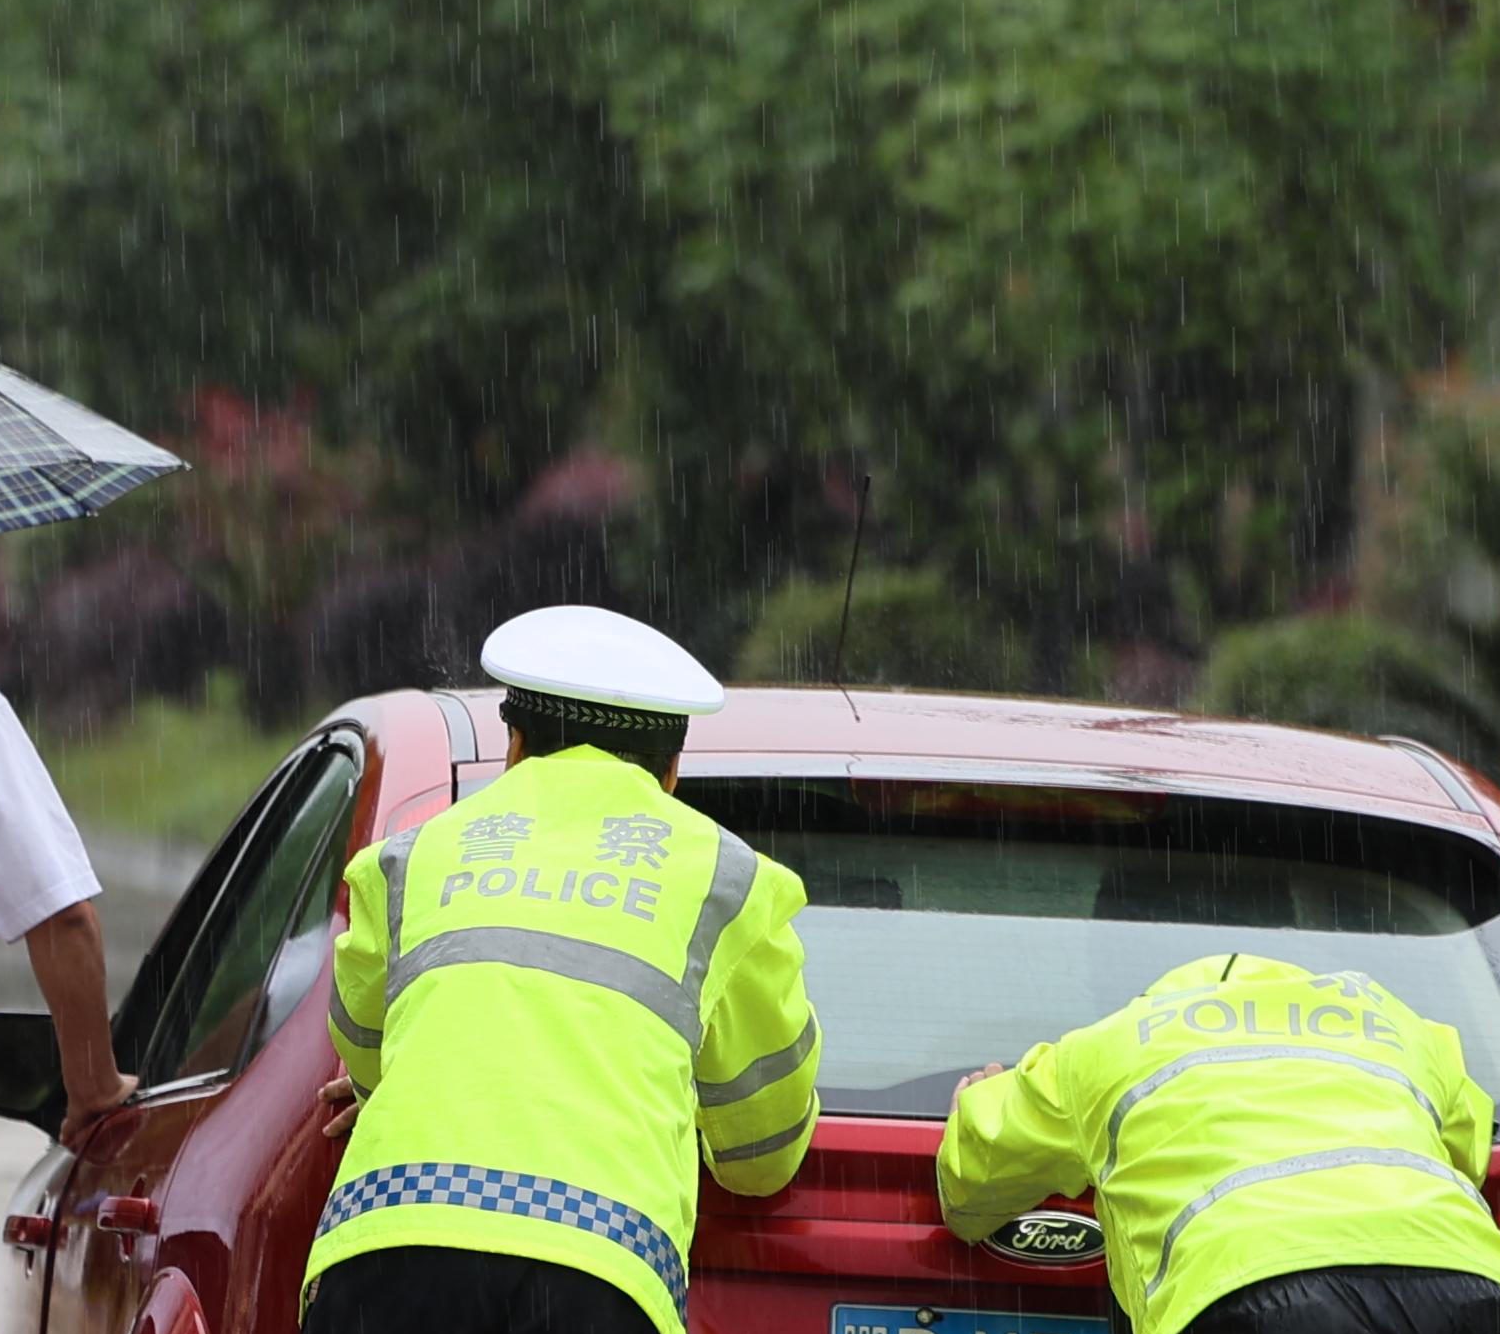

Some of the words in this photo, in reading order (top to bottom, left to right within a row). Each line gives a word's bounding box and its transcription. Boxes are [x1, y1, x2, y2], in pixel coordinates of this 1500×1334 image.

[457, 811, 673, 870] 警察
[439, 867, 663, 923] POLICE
[1137, 998, 1405, 1053] POLICE
[1011, 1218, 1088, 1251] Ford
